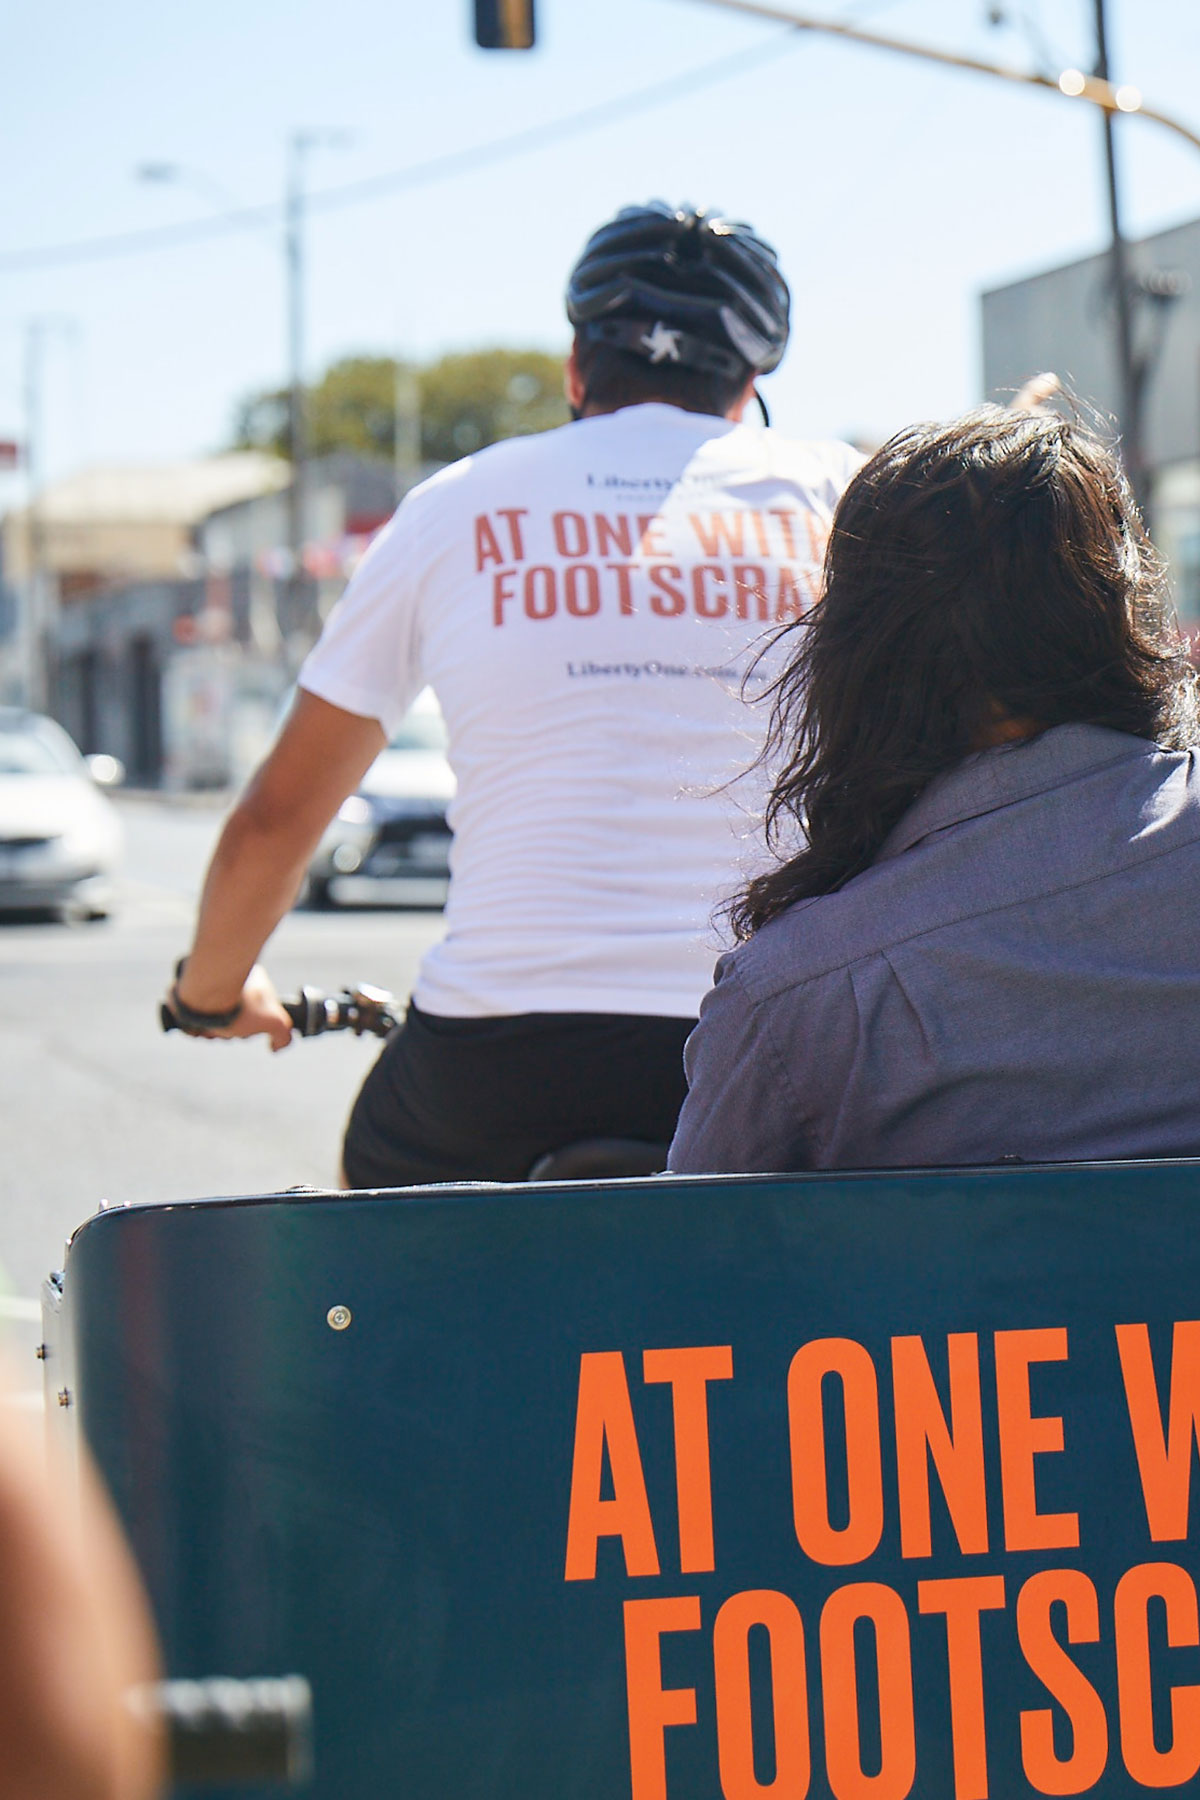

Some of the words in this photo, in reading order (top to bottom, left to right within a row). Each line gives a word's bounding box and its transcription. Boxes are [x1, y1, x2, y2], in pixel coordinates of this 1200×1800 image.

[474, 508, 528, 572] AT
[552, 510, 673, 557] ONE
[565, 1346, 732, 1580] AT
[788, 1328, 1079, 1565] ONE
